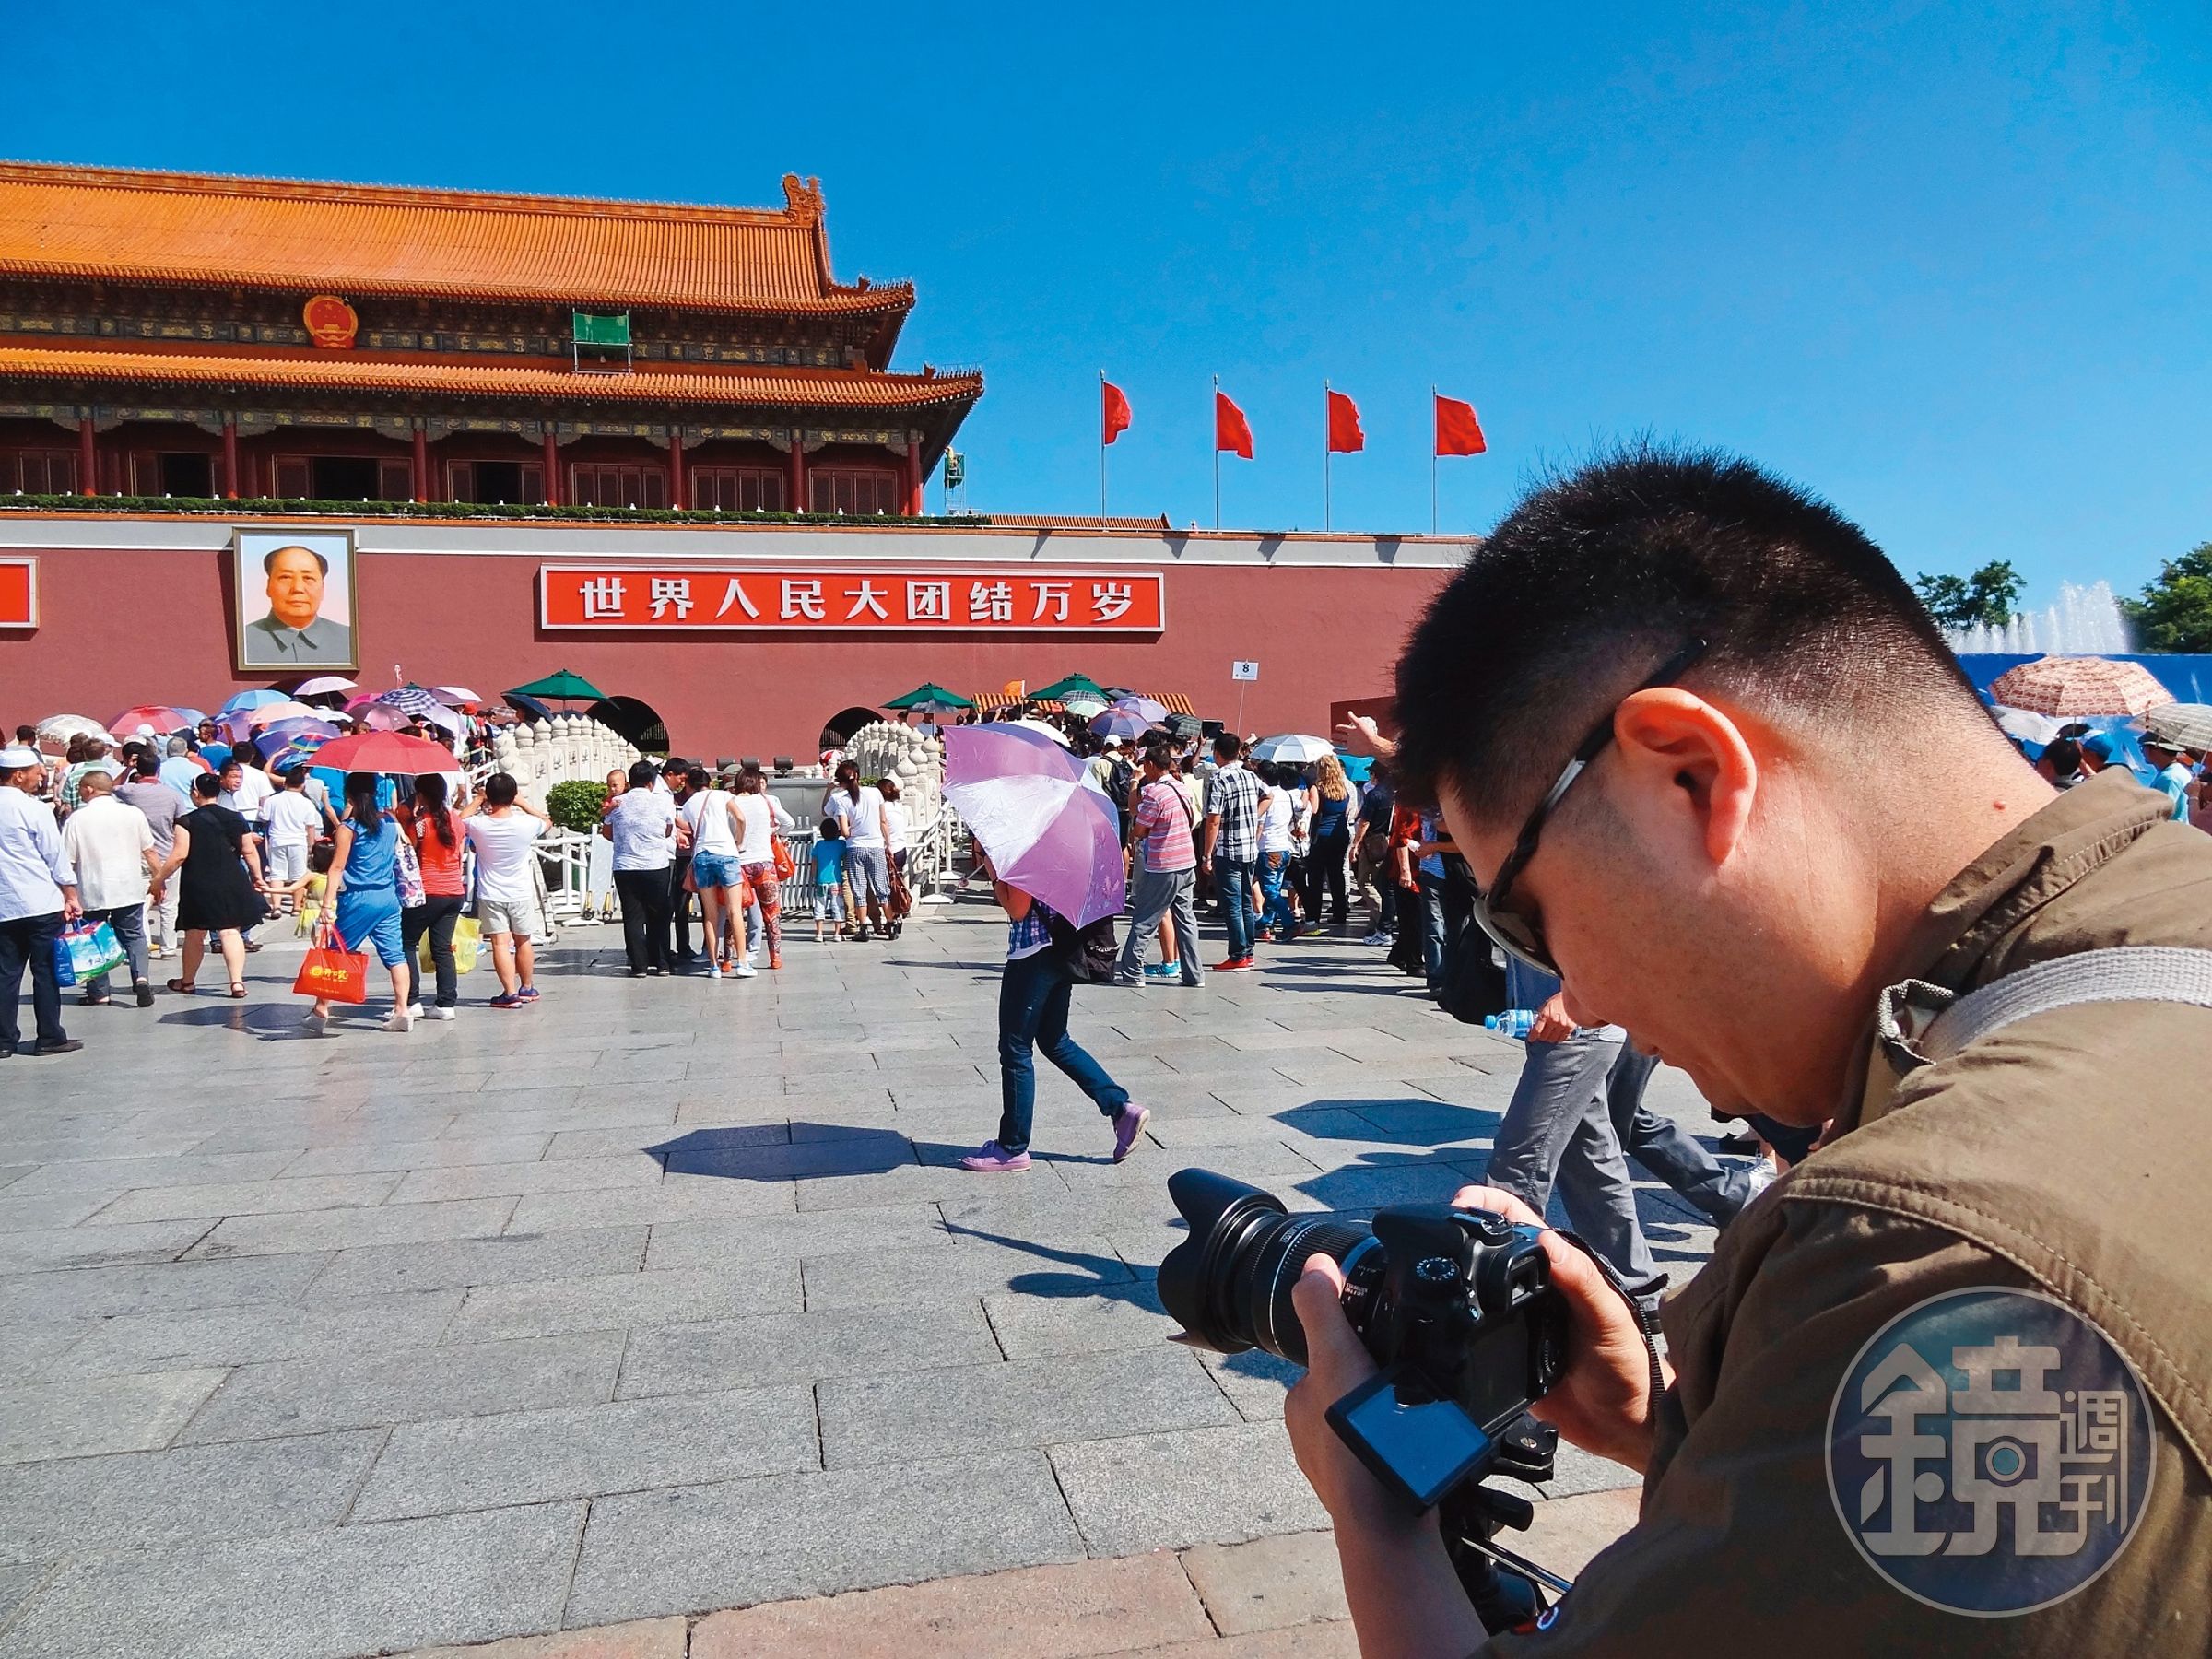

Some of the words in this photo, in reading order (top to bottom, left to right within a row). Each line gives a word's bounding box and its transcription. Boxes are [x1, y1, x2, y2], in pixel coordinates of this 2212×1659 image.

[579, 577, 1133, 621] 世界人民大团结万岁
[1242, 664, 1250, 673] 8
